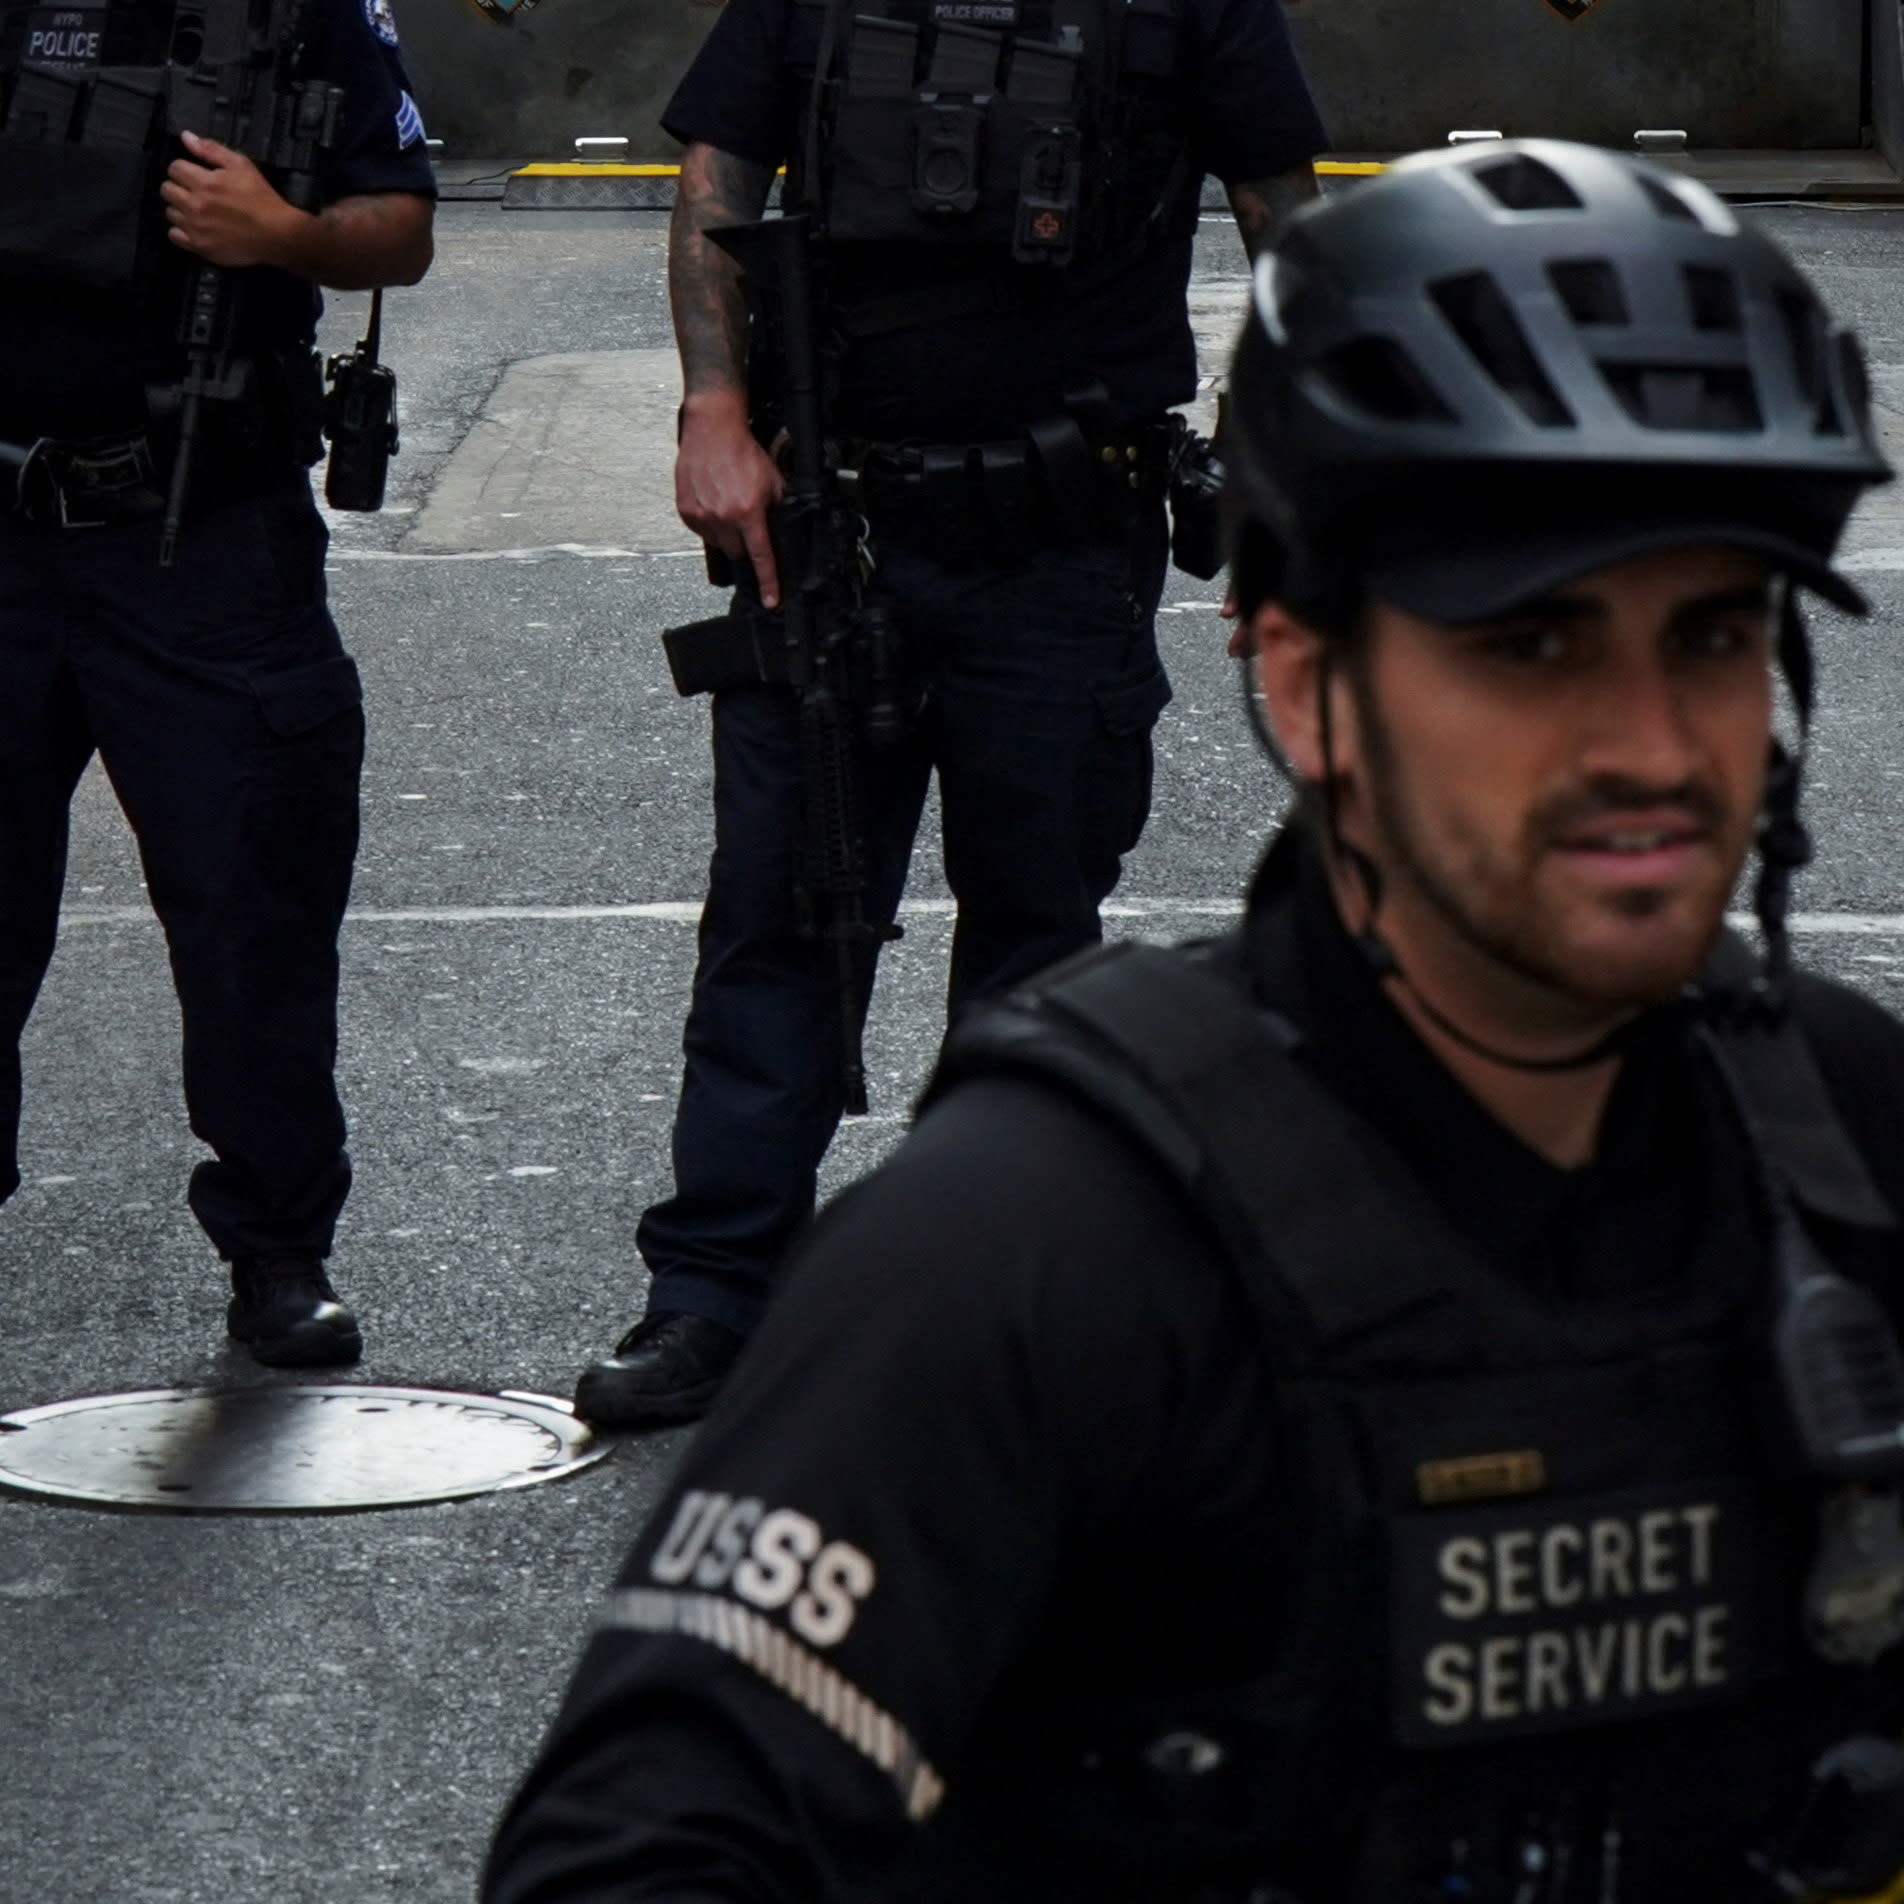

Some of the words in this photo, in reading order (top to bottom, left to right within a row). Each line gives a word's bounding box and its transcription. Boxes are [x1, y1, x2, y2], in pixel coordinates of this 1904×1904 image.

[28, 31, 101, 59] POLICE
[52, 12, 85, 27] NYPD
[935, 4, 972, 19] POLICE
[972, 4, 1016, 22] OFFICER
[649, 1487, 877, 1650] USSS
[1436, 1500, 1720, 1621] SECRET
[1422, 1602, 1731, 1727] SERVICE
